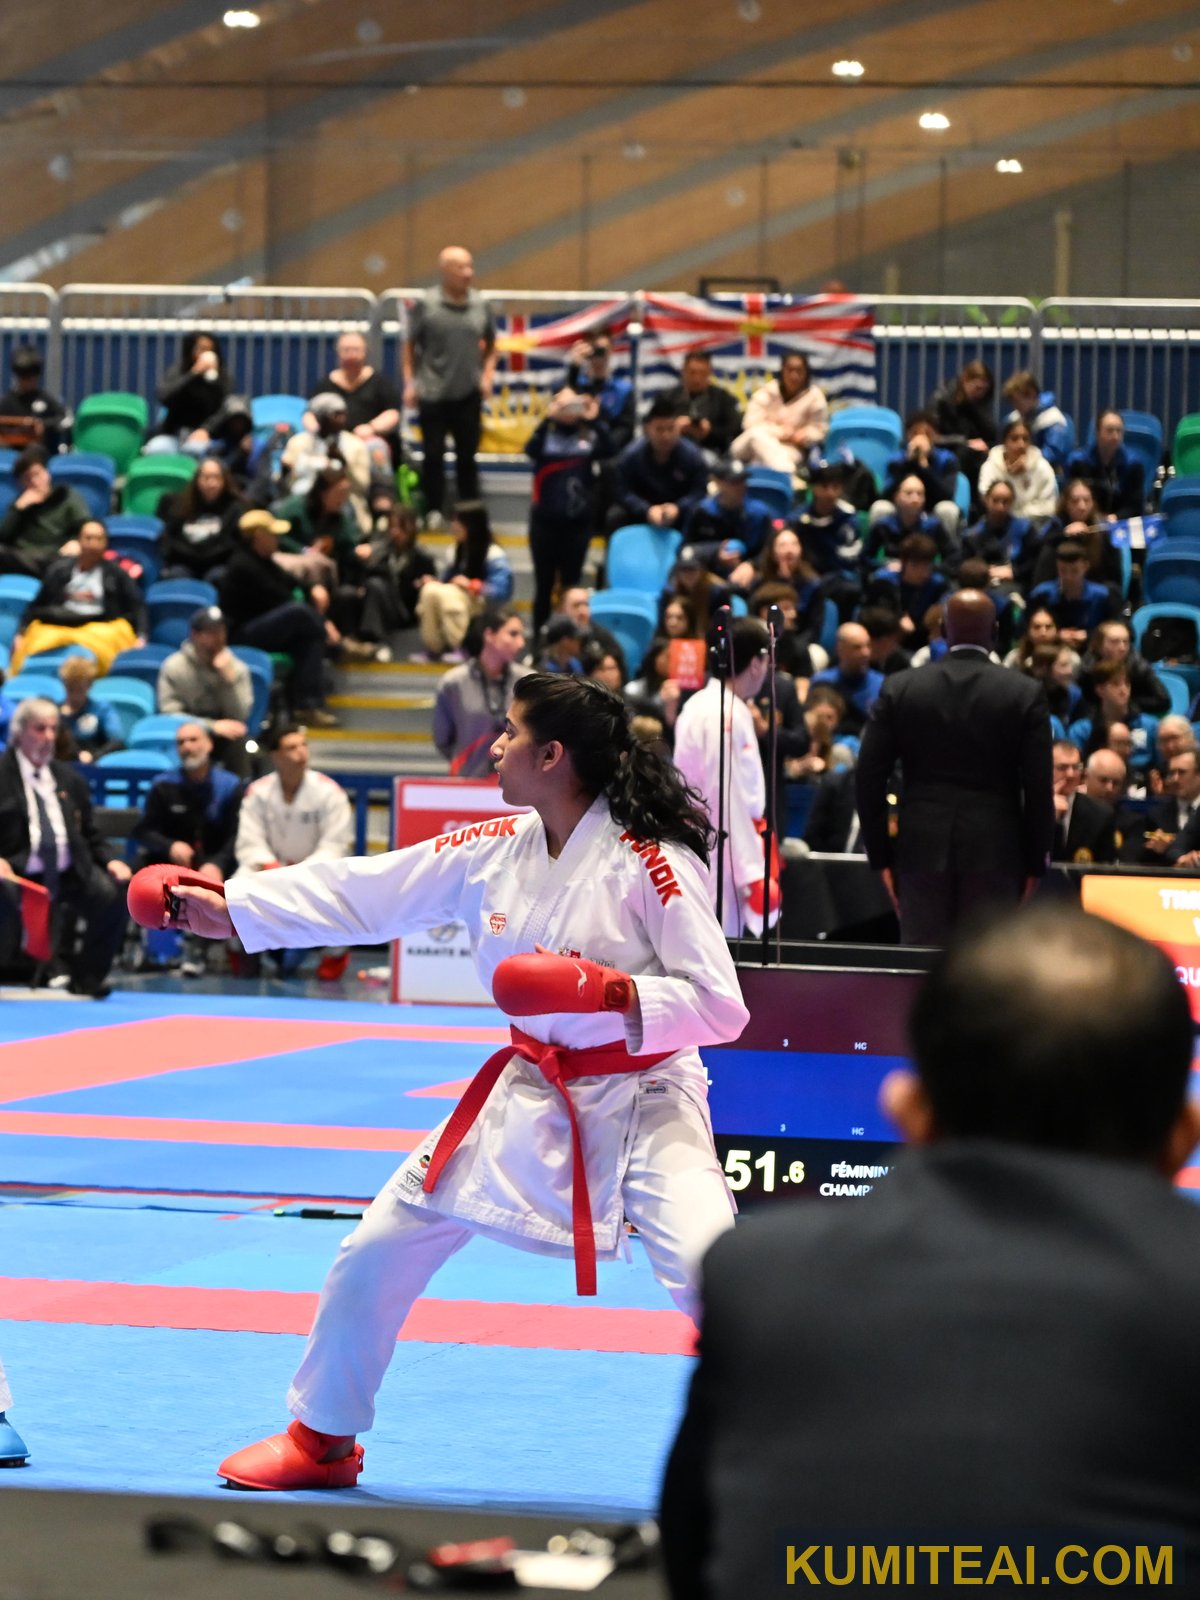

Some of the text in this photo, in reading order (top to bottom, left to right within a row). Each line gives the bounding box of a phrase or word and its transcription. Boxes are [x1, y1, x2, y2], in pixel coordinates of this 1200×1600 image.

[434, 817, 518, 853] PUNOK
[854, 1041, 868, 1051] HC
[851, 1127, 865, 1136] HC
[819, 1183, 873, 1197] CHAMP
